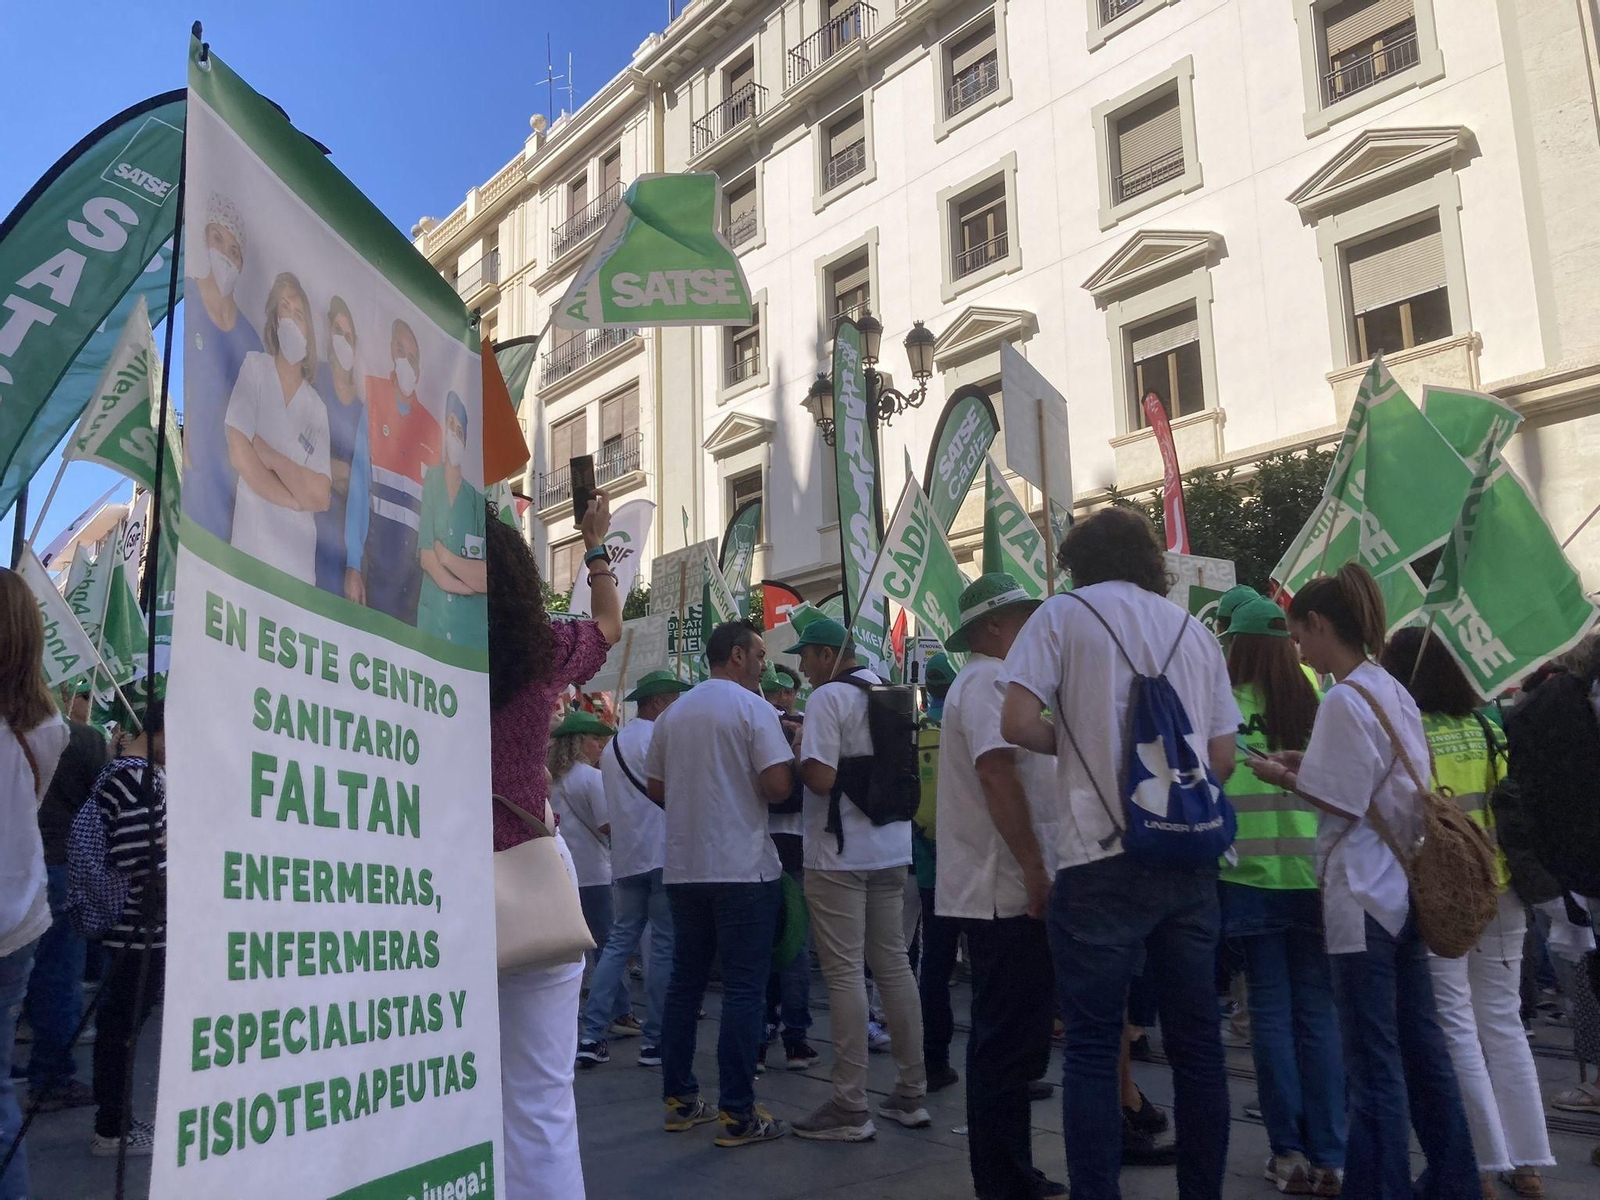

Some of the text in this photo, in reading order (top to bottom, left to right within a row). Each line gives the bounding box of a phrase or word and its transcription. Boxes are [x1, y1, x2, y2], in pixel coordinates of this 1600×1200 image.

[114, 163, 172, 198] SATSE
[611, 269, 741, 308] SATSE
[939, 404, 980, 481] SATSE
[949, 432, 988, 500] Cádiz
[607, 545, 634, 563] SIF
[206, 590, 458, 718] EN ESTE CENTRO
[252, 687, 420, 765] SANITARIO
[250, 751, 421, 838] FALTAN
[1144, 820, 1190, 833] UNDER
[223, 851, 442, 913] ENFERMERAS,
[227, 930, 440, 980] ENFERMERAS
[191, 990, 467, 1071] ESPECIALISTAS Y
[177, 1051, 478, 1167] FISIOTERAPEUTAS
